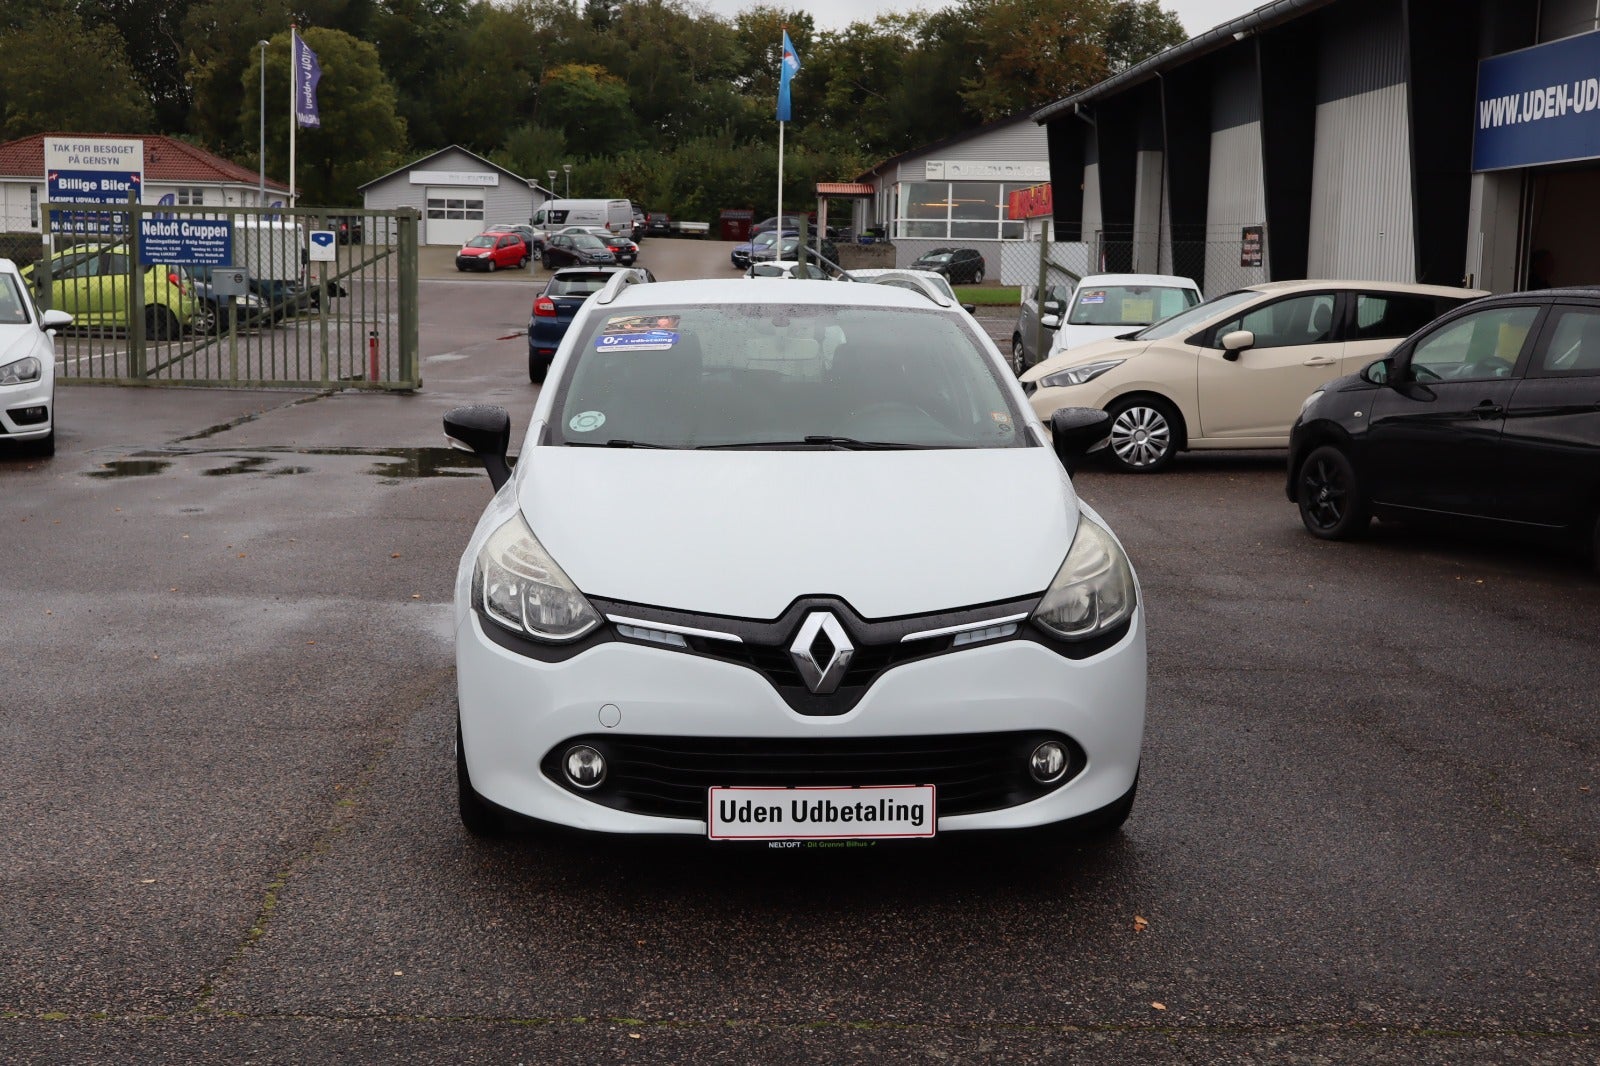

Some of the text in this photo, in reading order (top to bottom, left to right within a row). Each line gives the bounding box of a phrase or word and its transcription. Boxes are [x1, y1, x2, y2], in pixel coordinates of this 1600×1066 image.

[1480, 77, 1600, 129] WWW.UDEN-UD
[53, 144, 134, 154] TAK FOR BESØGET
[68, 153, 119, 165] PÅ GENSYN
[58, 178, 131, 192] Billige Biler
[75, 196, 100, 204] UDVALG
[142, 221, 179, 237] Neltoft
[181, 222, 228, 240] Gruppen
[719, 798, 924, 827] Uden Udbetaling
[768, 841, 801, 849] NELTOFT
